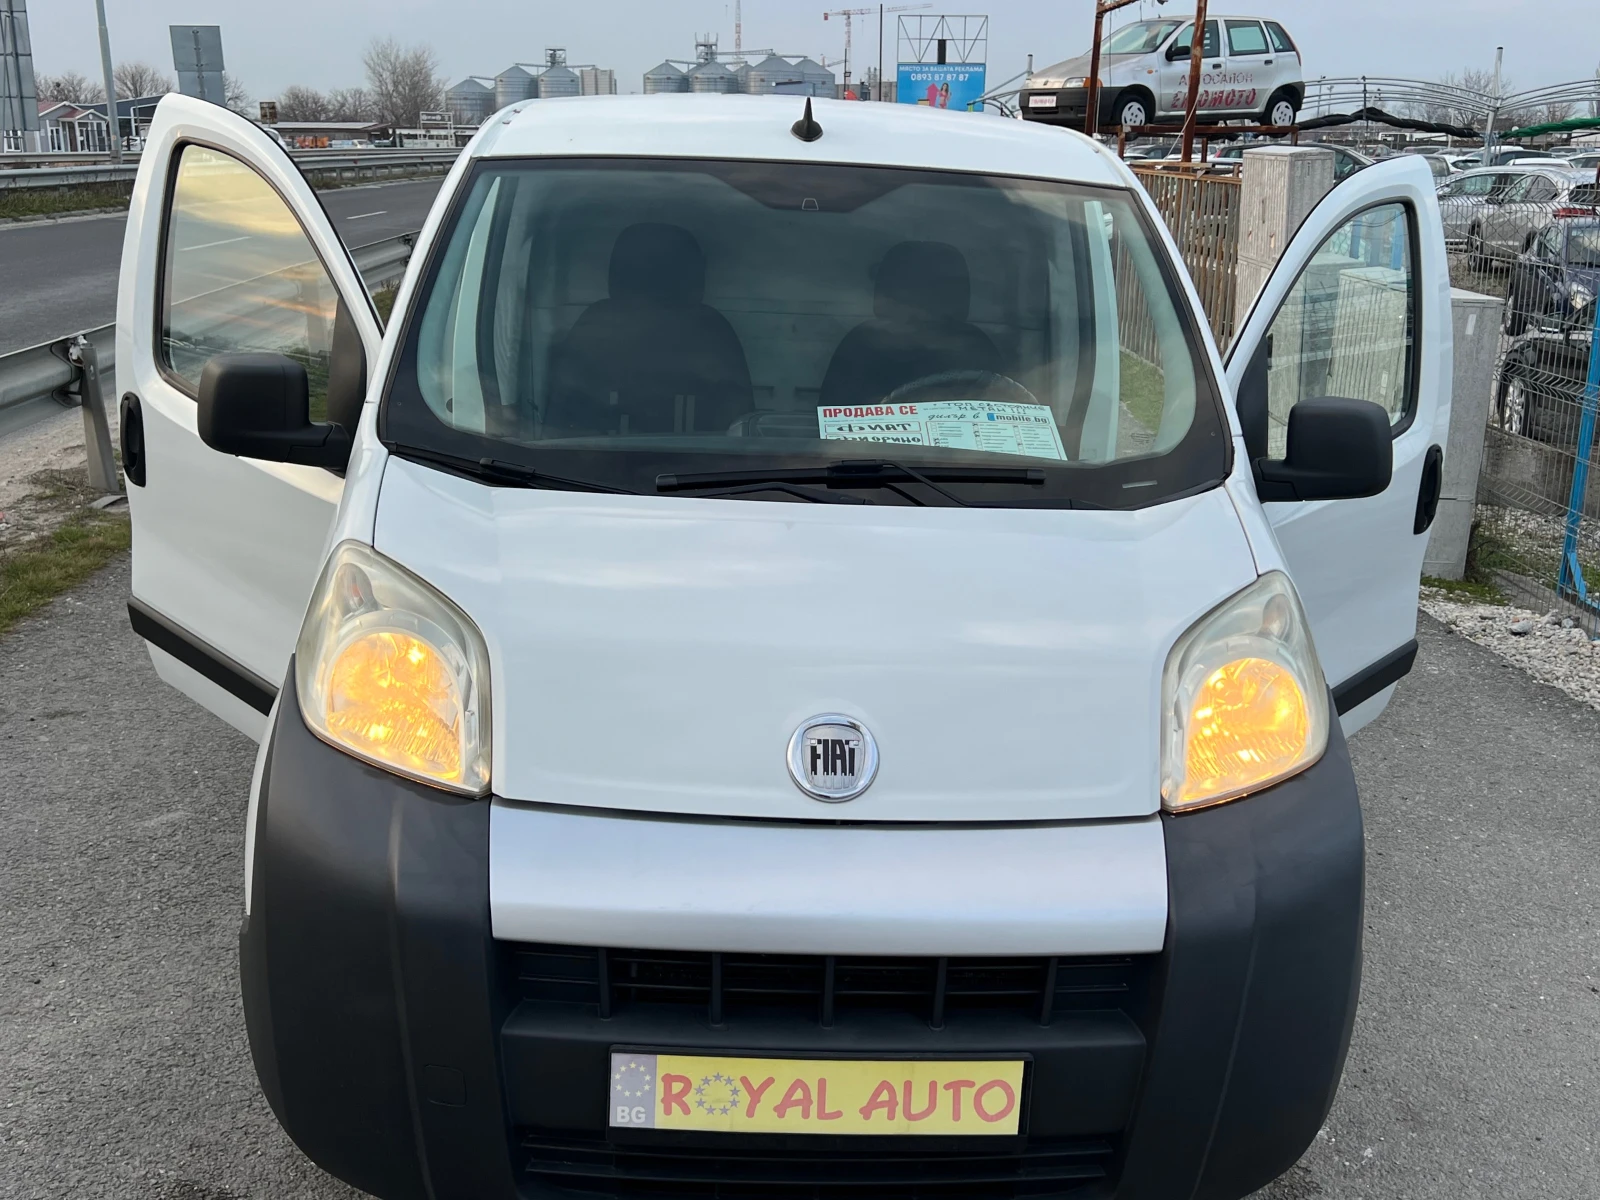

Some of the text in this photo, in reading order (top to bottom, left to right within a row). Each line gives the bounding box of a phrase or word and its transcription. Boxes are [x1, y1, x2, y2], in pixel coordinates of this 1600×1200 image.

[910, 73, 969, 81] 0893 87 87 87
[1179, 72, 1253, 86] АОСАЛОН
[823, 406, 895, 418] ПРОДАВА
[899, 405, 918, 415] СЕ
[995, 413, 1048, 424] mobile.bg
[836, 423, 911, 433] ФИАТ
[810, 738, 859, 777] FIAT
[661, 1072, 1016, 1123] ROYAL AUTO
[616, 1106, 646, 1124] BG
